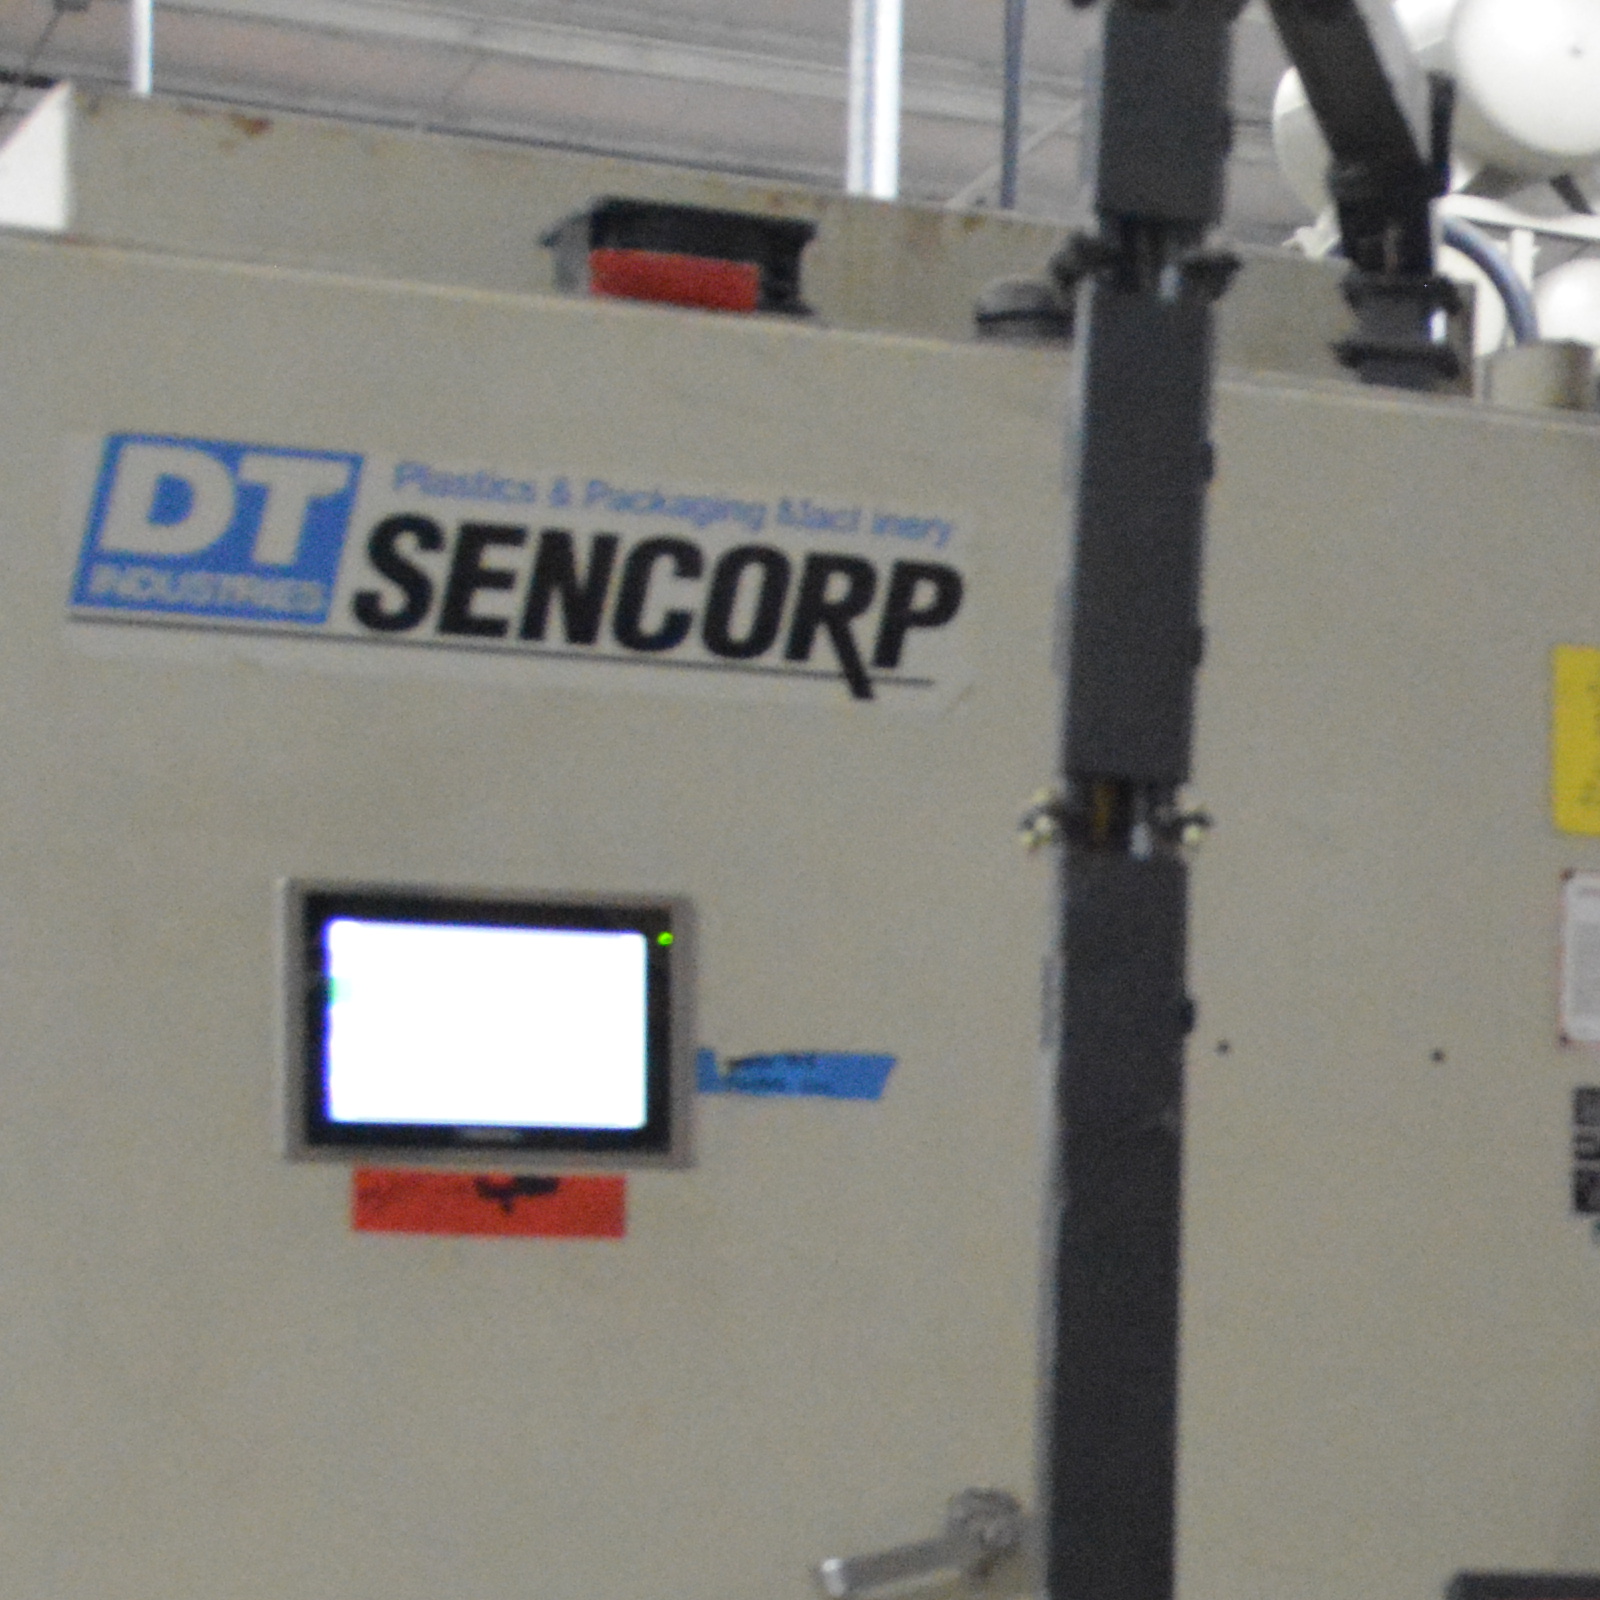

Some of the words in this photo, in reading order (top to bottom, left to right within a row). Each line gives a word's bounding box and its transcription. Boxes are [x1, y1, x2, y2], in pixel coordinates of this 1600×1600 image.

[99, 443, 350, 566] DT
[393, 461, 536, 502] Plastics
[548, 477, 574, 507] &
[584, 479, 766, 532] Packaging
[353, 512, 964, 700] SENCORP
